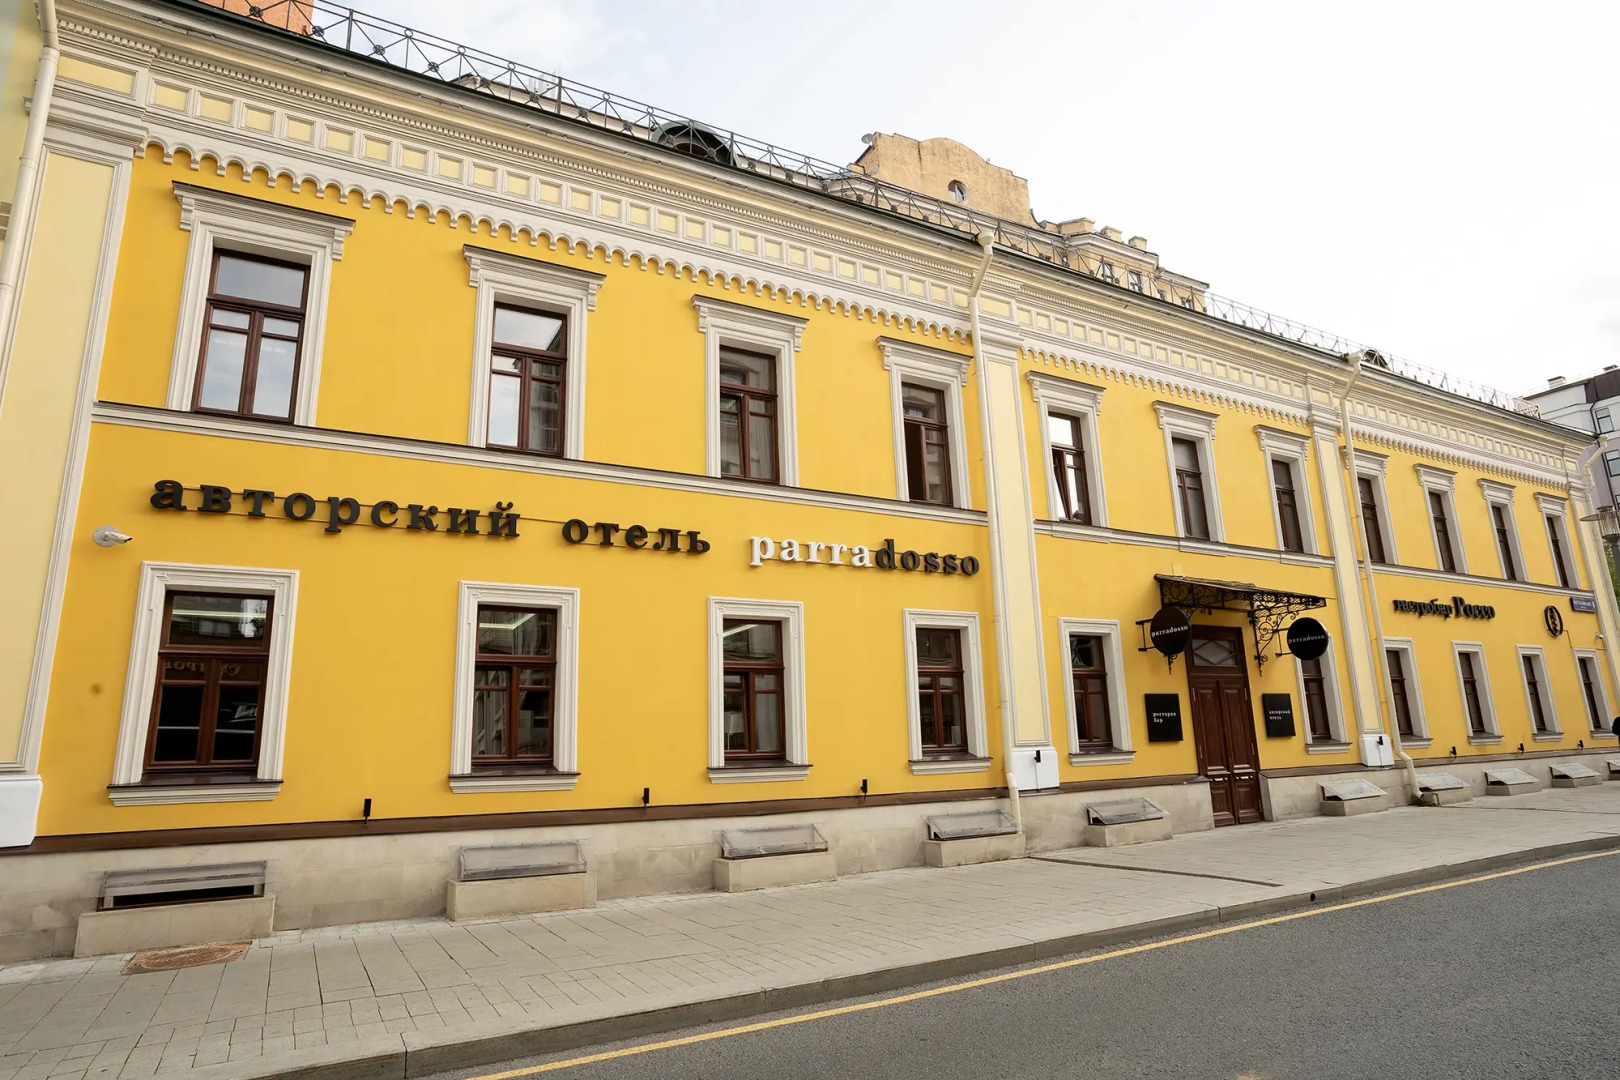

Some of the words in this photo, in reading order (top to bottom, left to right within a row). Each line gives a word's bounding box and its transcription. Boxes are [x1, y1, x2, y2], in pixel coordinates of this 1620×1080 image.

[150, 479, 520, 537] авторский
[562, 518, 711, 554] отель
[750, 536, 980, 576] parradosso
[1392, 598, 1453, 620] гастробар
[1151, 626, 1188, 637] parradosso
[1288, 634, 1325, 644] parradosso
